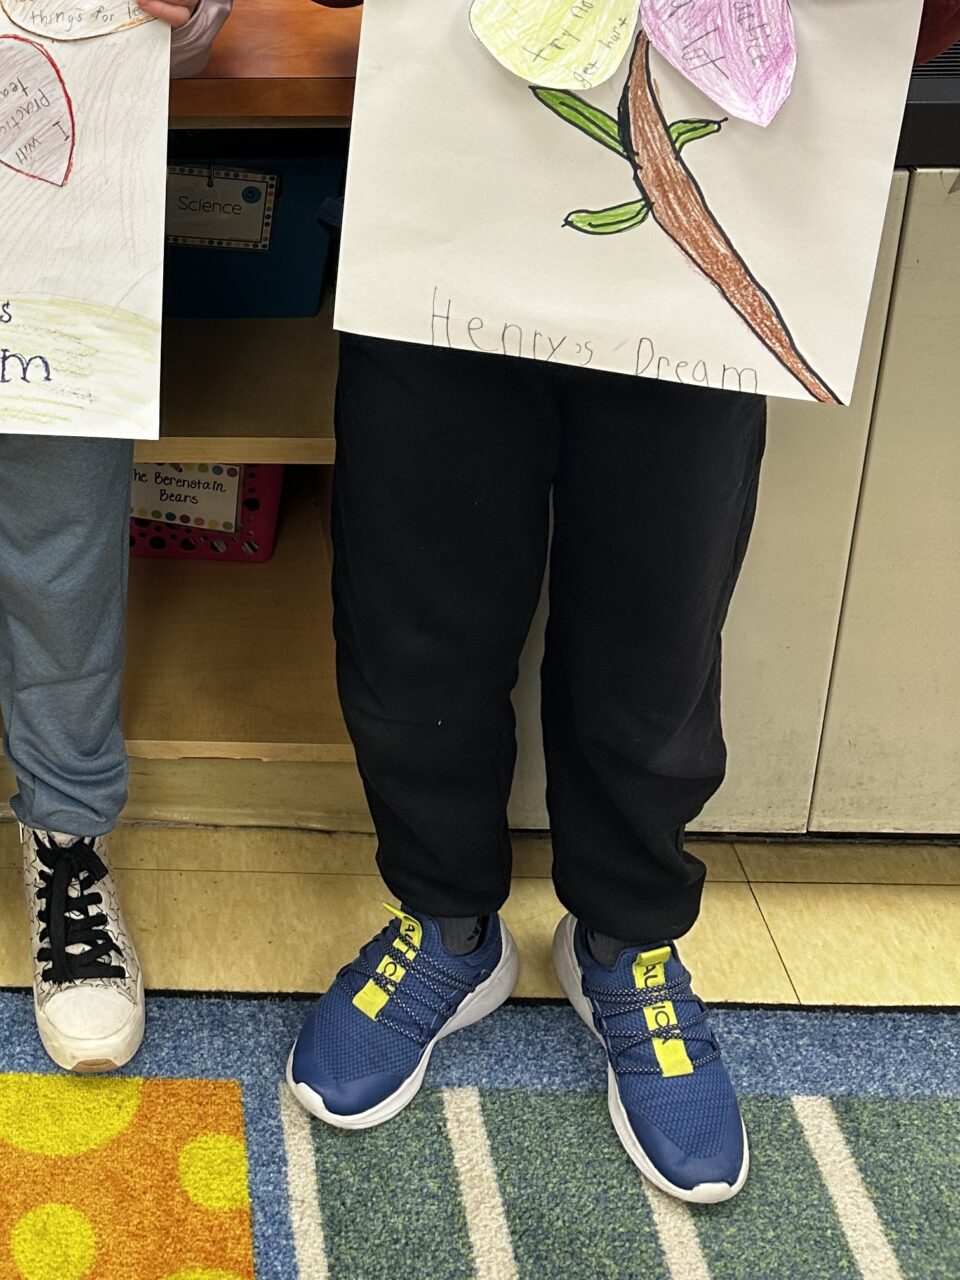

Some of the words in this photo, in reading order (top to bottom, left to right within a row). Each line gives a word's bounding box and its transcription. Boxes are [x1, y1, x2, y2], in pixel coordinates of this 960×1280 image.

[30, 7, 82, 31] things
[93, 5, 114, 21] for
[52, 120, 70, 141] I
[15, 137, 42, 165] will
[178, 195, 242, 215] Science
[635, 337, 758, 394] Dream
[154, 471, 227, 493] Berenstain
[159, 489, 199, 505] Bears
